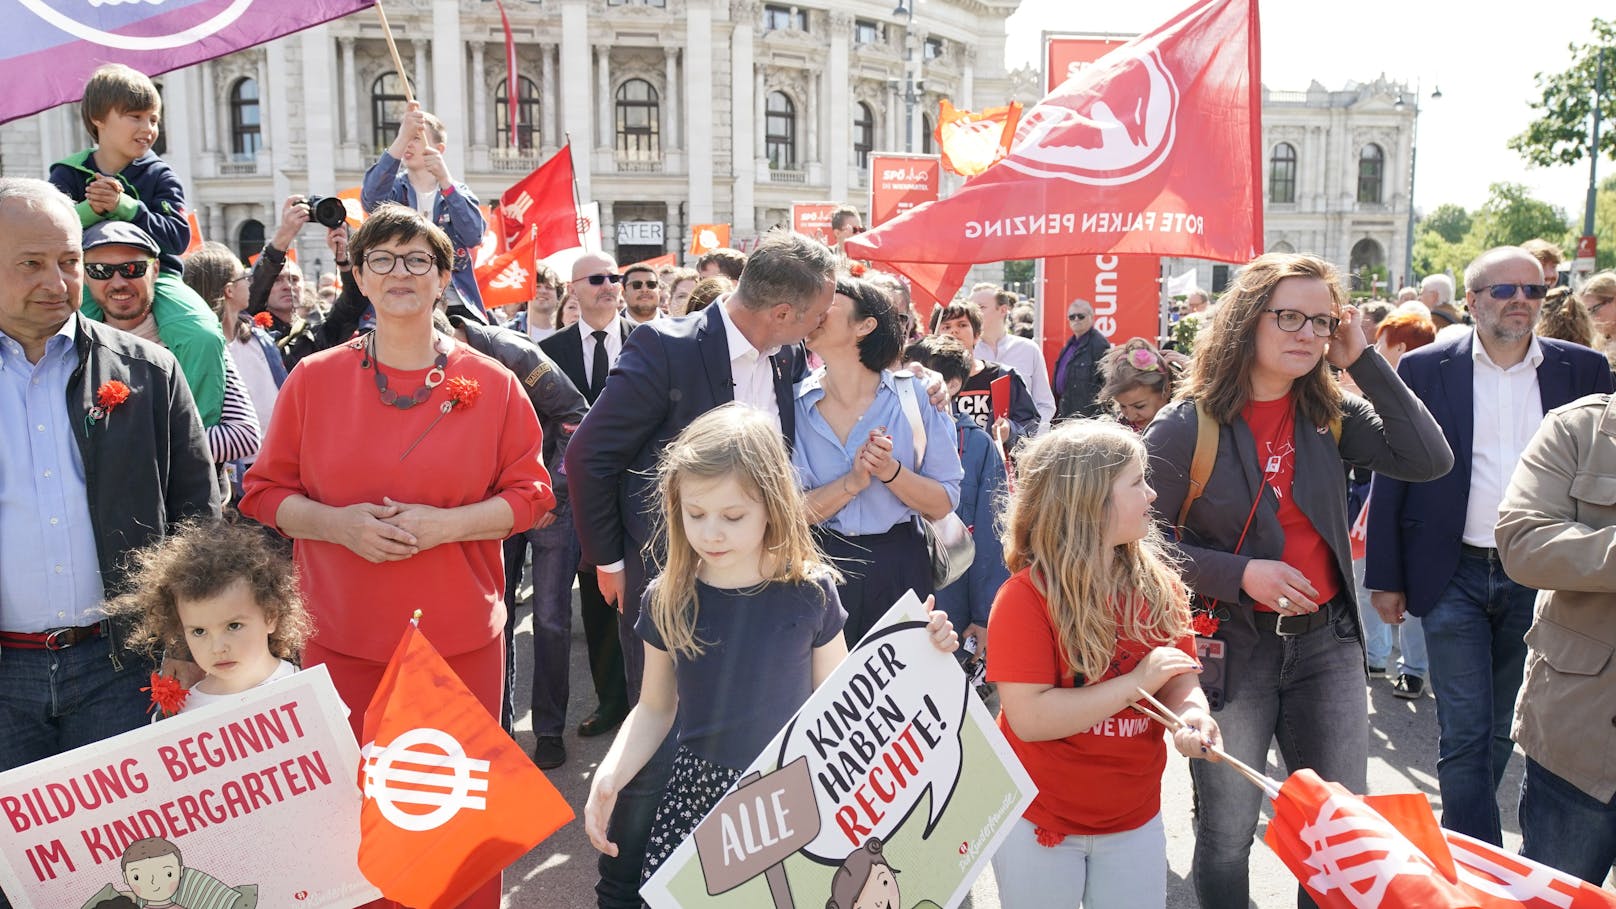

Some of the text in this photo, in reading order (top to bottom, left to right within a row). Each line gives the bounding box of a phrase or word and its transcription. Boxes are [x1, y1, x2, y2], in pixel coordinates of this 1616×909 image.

[883, 168, 905, 180] SPÖ
[955, 395, 990, 414] CK
[806, 643, 907, 760] KINDER
[818, 694, 906, 804] HABEN
[0, 701, 305, 833] BILDUNG BEGINNT
[25, 750, 332, 882] IM KINDERGARTEN
[835, 694, 947, 848] RECHTE!
[721, 789, 794, 866] ALLE
